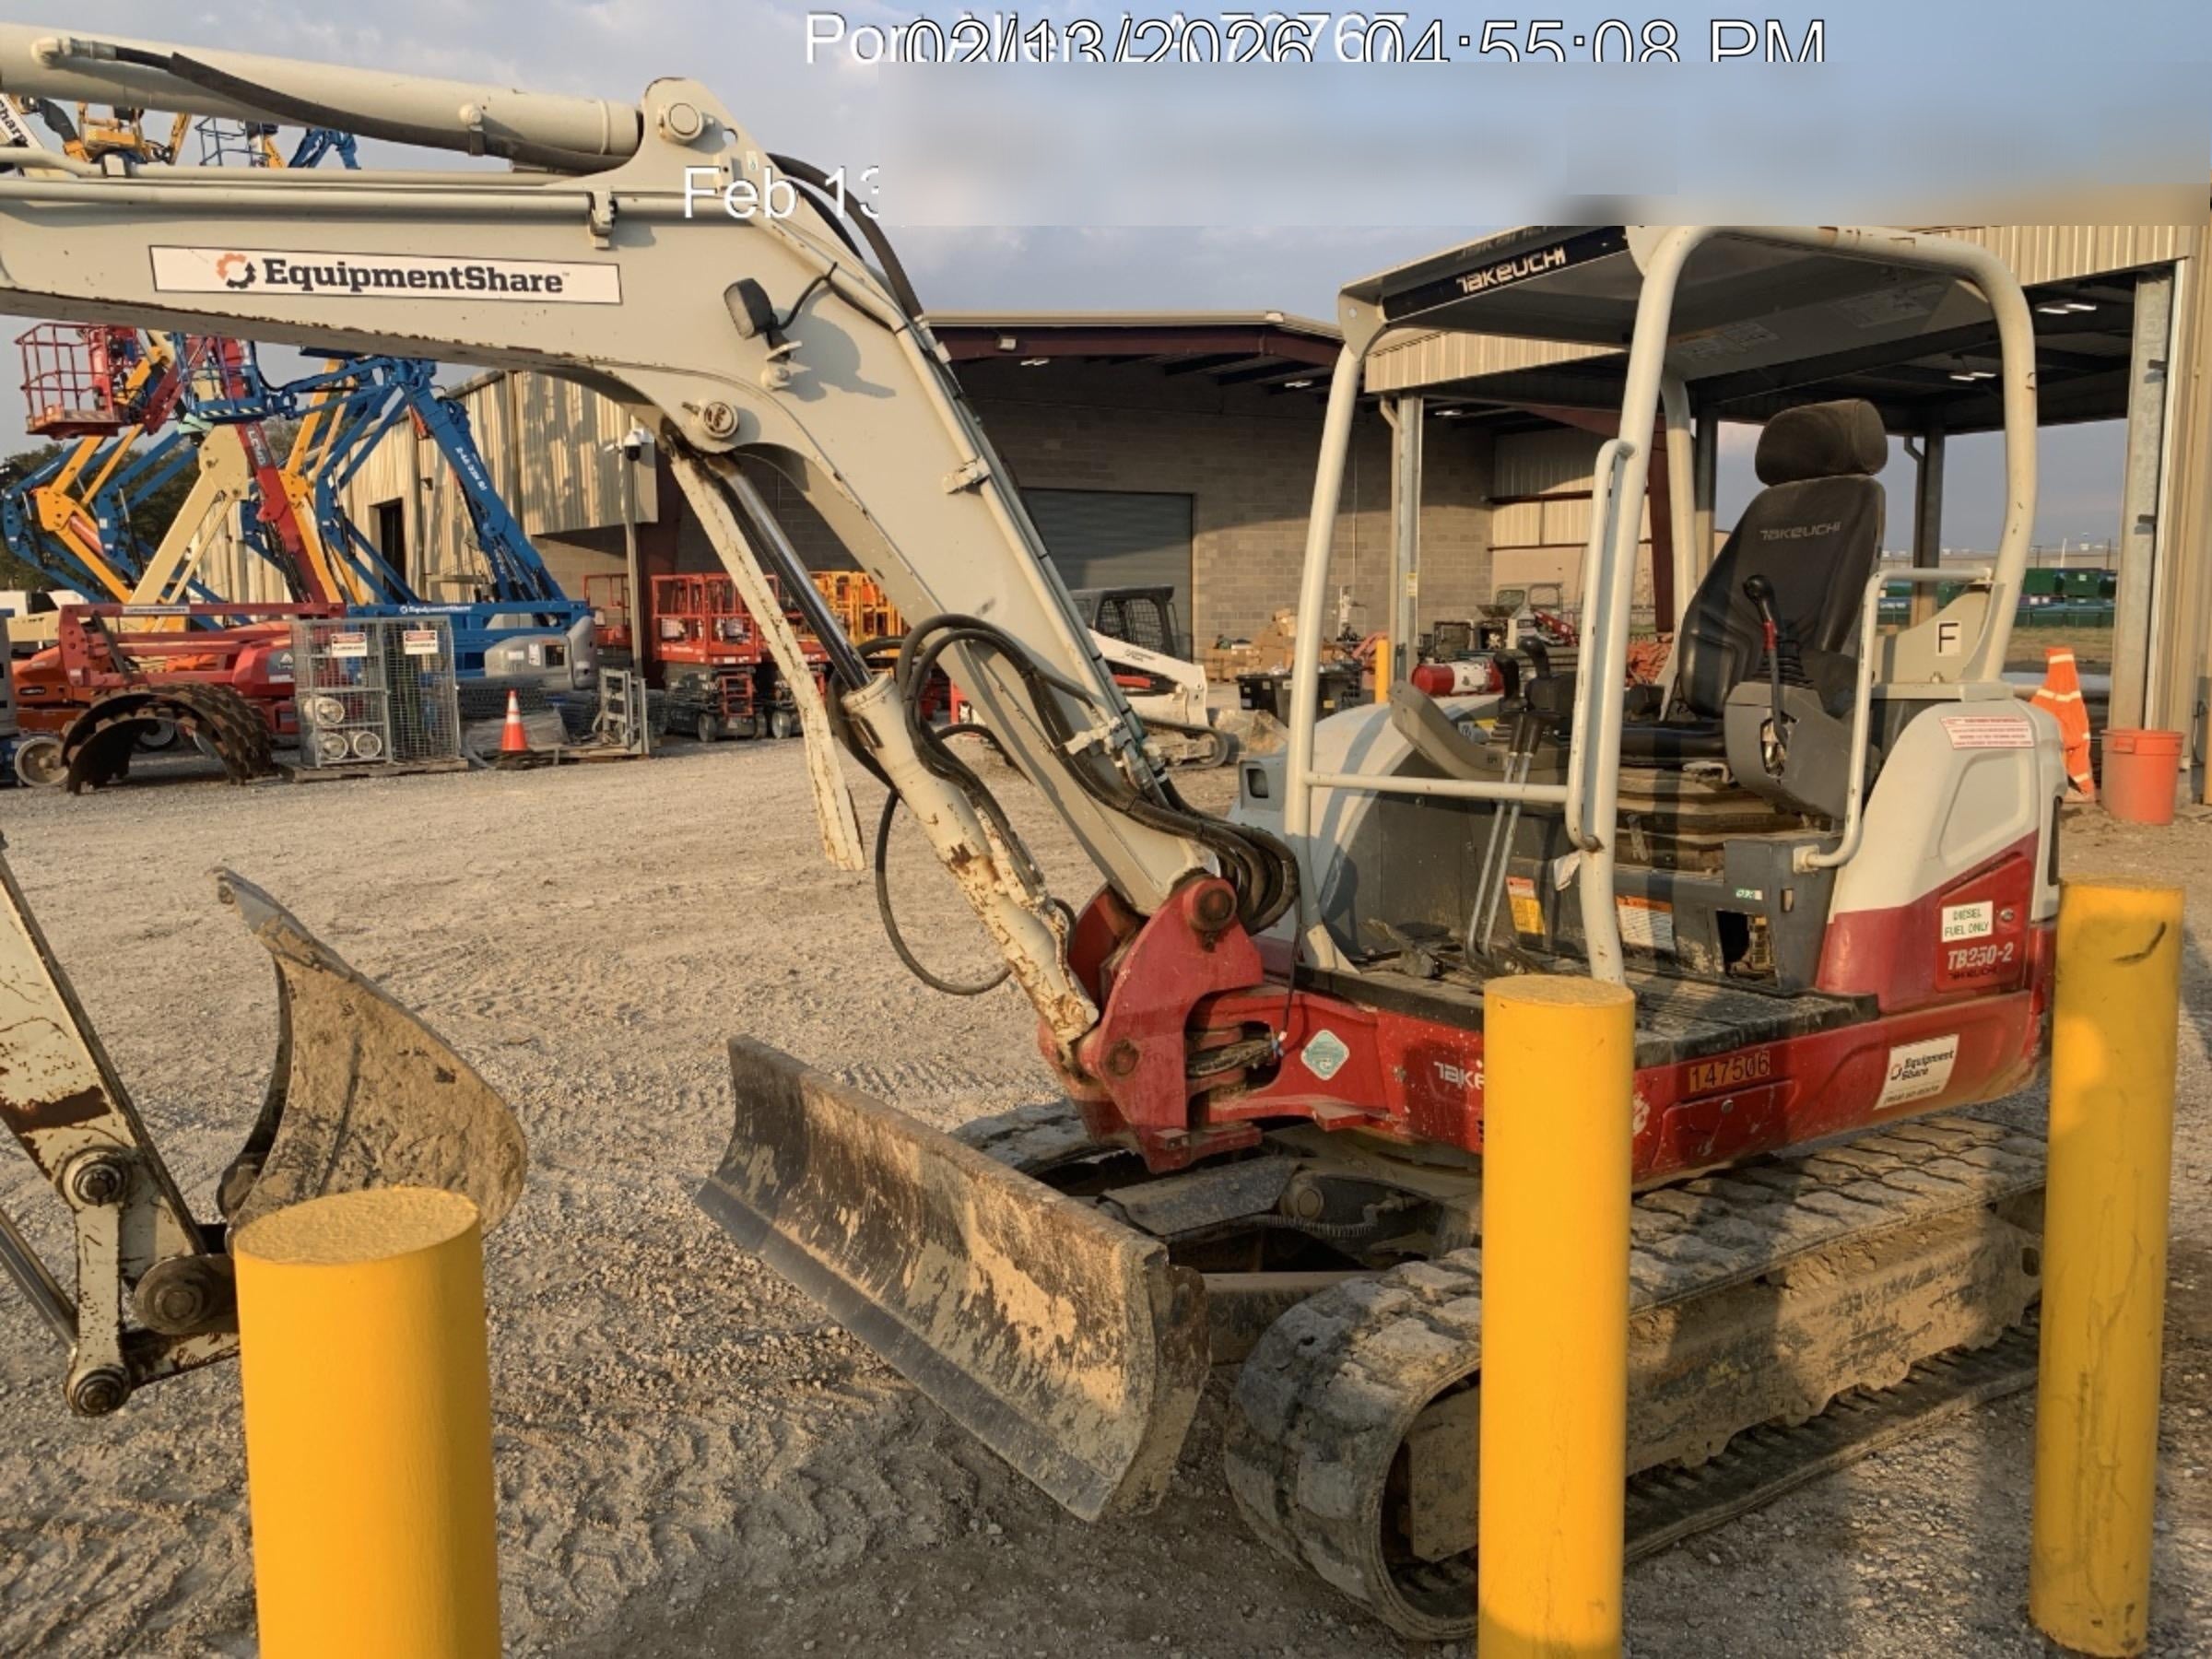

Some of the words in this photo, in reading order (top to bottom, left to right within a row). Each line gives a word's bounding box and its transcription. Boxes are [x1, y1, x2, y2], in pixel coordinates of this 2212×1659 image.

[262, 258, 563, 293] EquipmentShare
[1938, 622, 1959, 653] F
[1944, 924, 1965, 937] FUEL
[1968, 921, 1990, 935] ONLY
[1953, 907, 1983, 921] DIESEL
[1947, 941, 2014, 971] TB250-2
[1691, 1052, 1770, 1092] 147506
